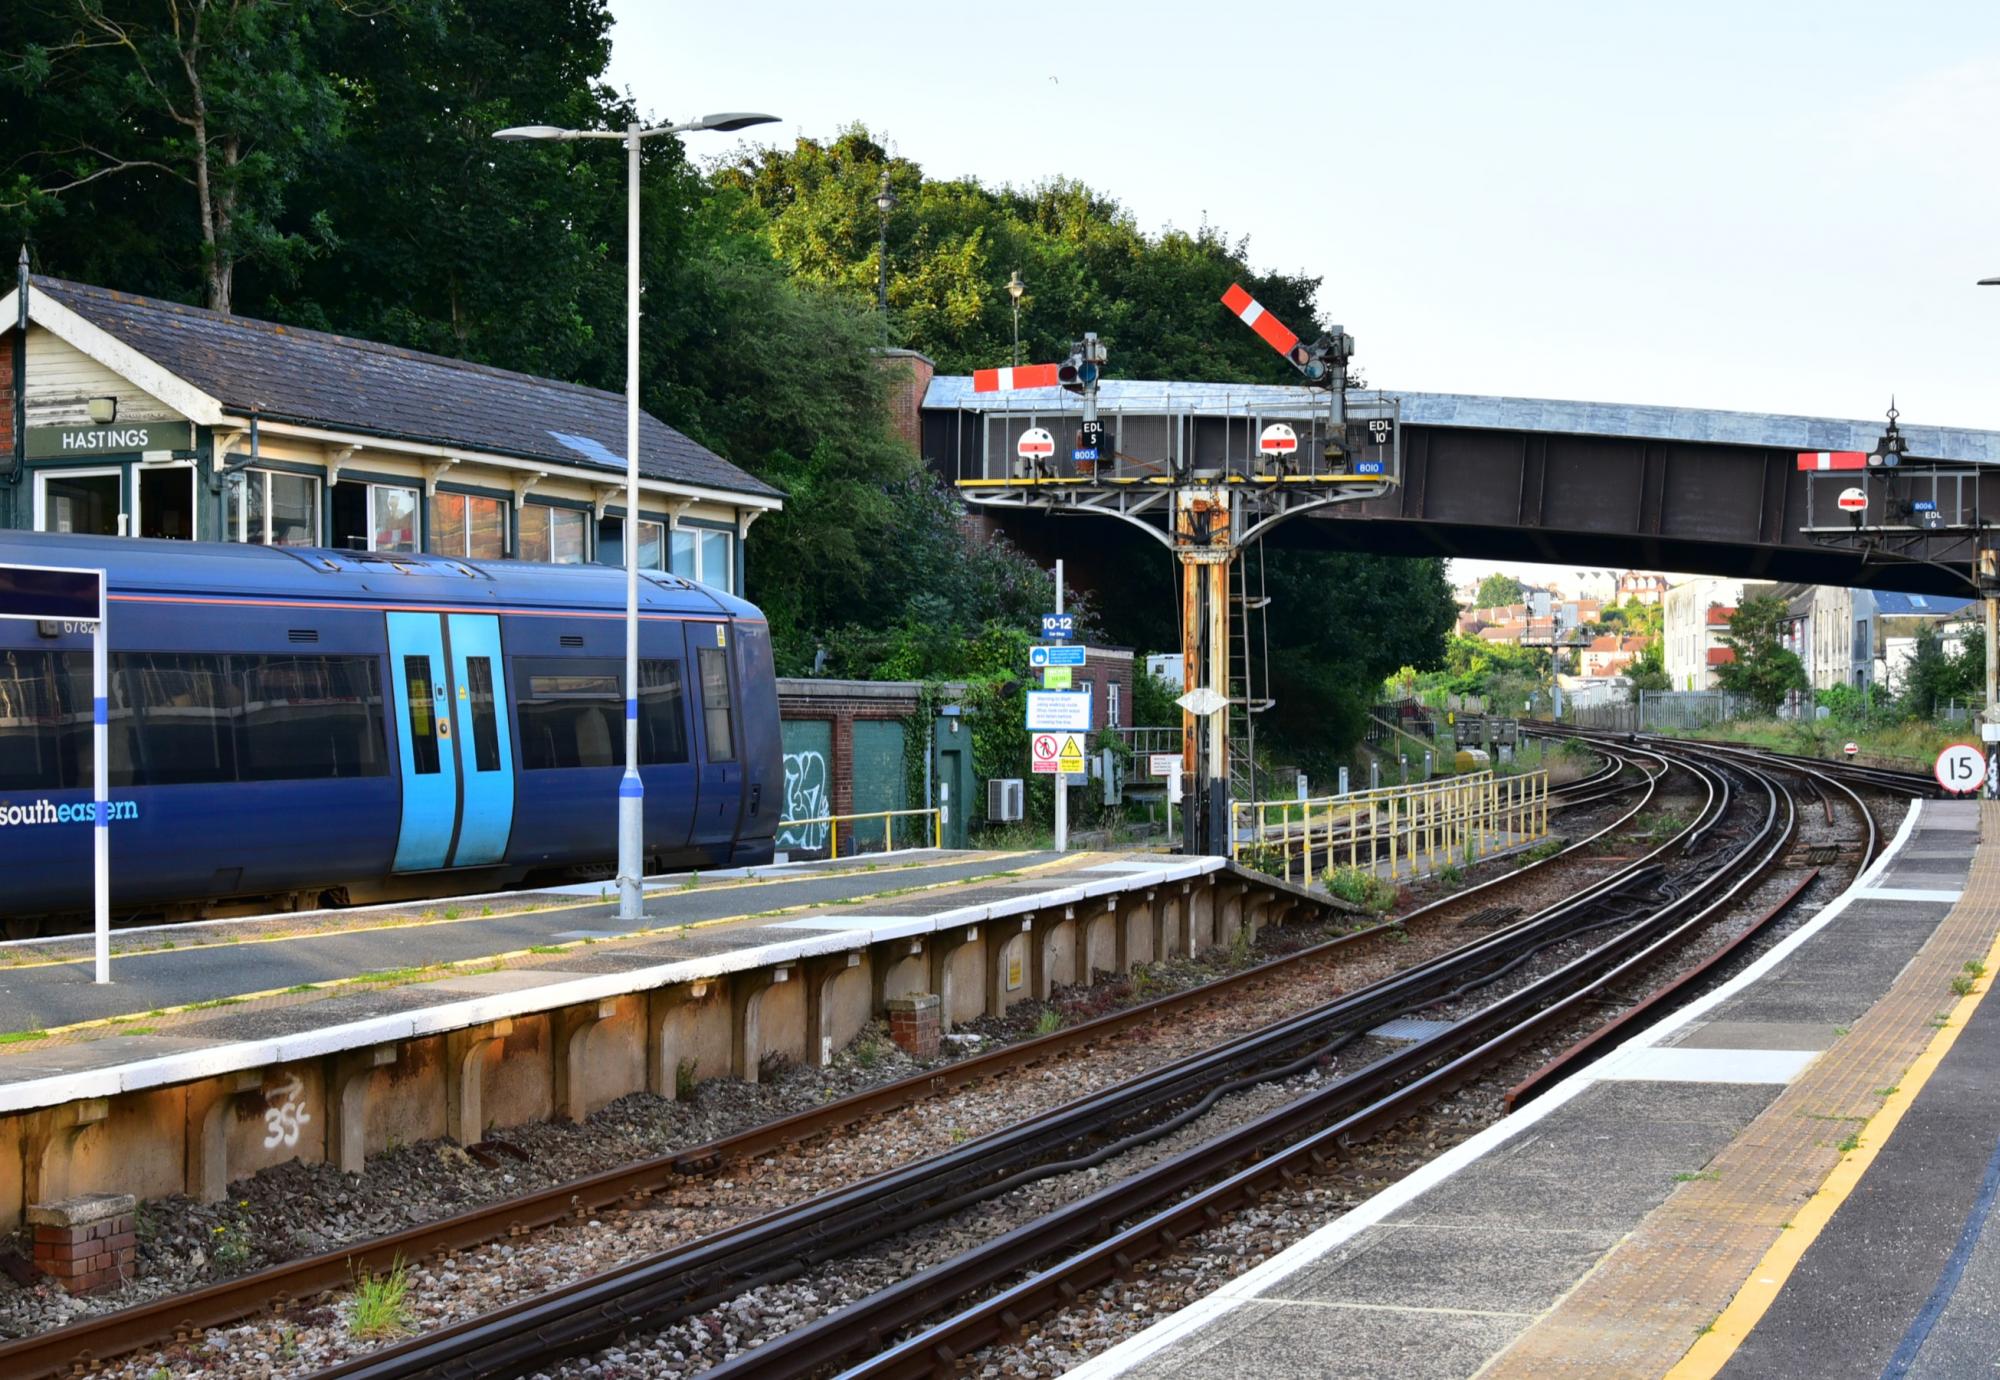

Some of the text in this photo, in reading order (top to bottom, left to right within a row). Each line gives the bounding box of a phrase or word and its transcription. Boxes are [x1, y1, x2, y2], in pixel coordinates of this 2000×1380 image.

[1083, 422, 1103, 433] EDL
[1369, 420, 1392, 431] EDL
[62, 429, 149, 449] HASTINGS
[1090, 434, 1097, 444] 5
[1375, 433, 1386, 443] 10
[1074, 450, 1095, 460] 8005
[1360, 463, 1379, 473] 8010
[1924, 511, 1943, 520] EDL
[1930, 520, 1937, 528] 6
[1042, 617, 1073, 630] 10-12
[1949, 756, 1973, 781] 15
[0, 799, 139, 826] southeasern
